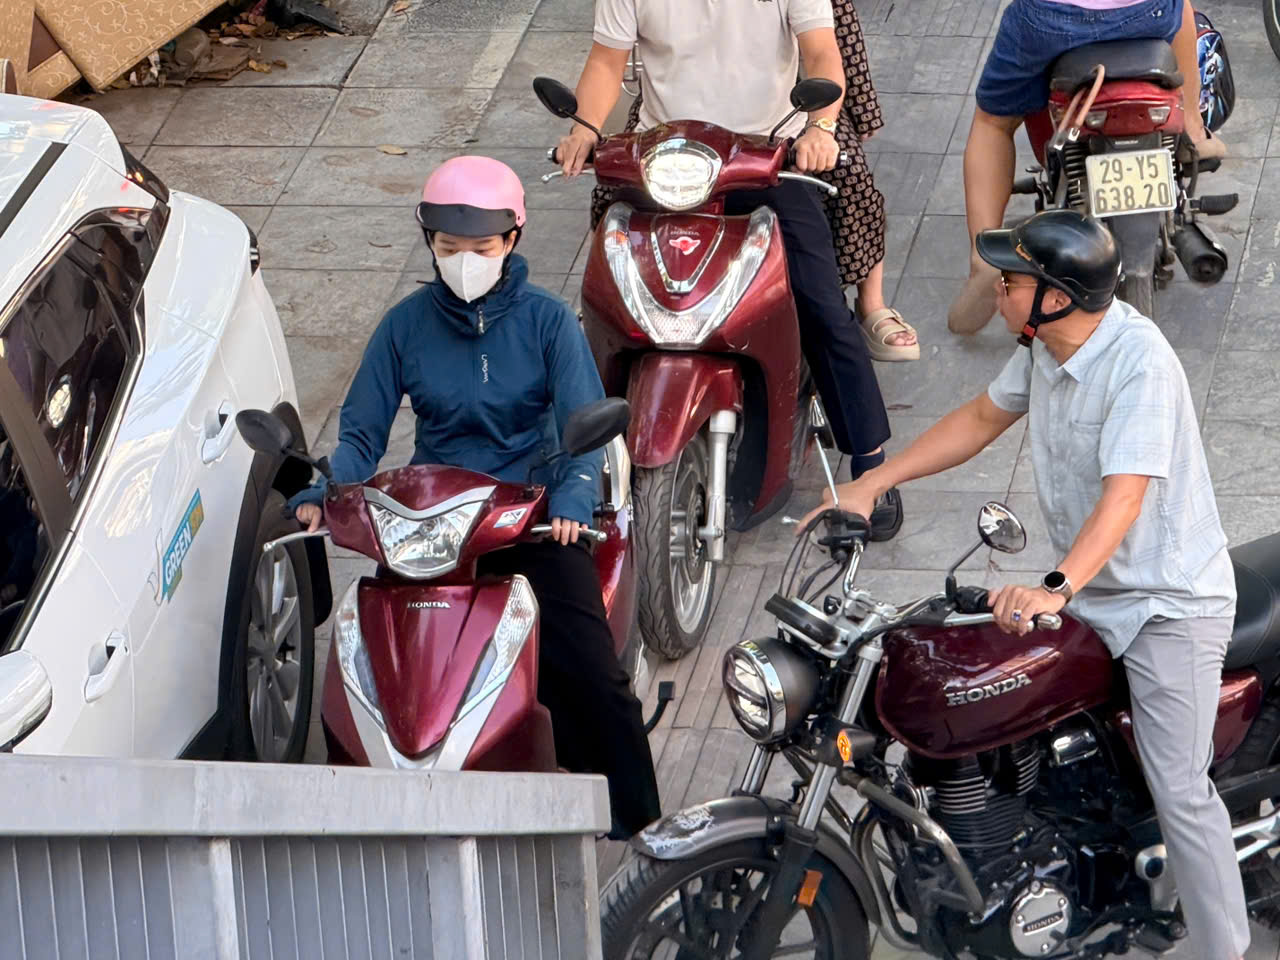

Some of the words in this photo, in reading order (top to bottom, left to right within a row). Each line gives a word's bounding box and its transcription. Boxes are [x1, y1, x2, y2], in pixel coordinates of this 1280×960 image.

[1099, 154, 1159, 185] 29-Y5
[1095, 182, 1170, 214] 638.20
[165, 521, 193, 586] GREEN
[407, 601, 451, 609] HONDA
[945, 673, 1032, 707] HONDA
